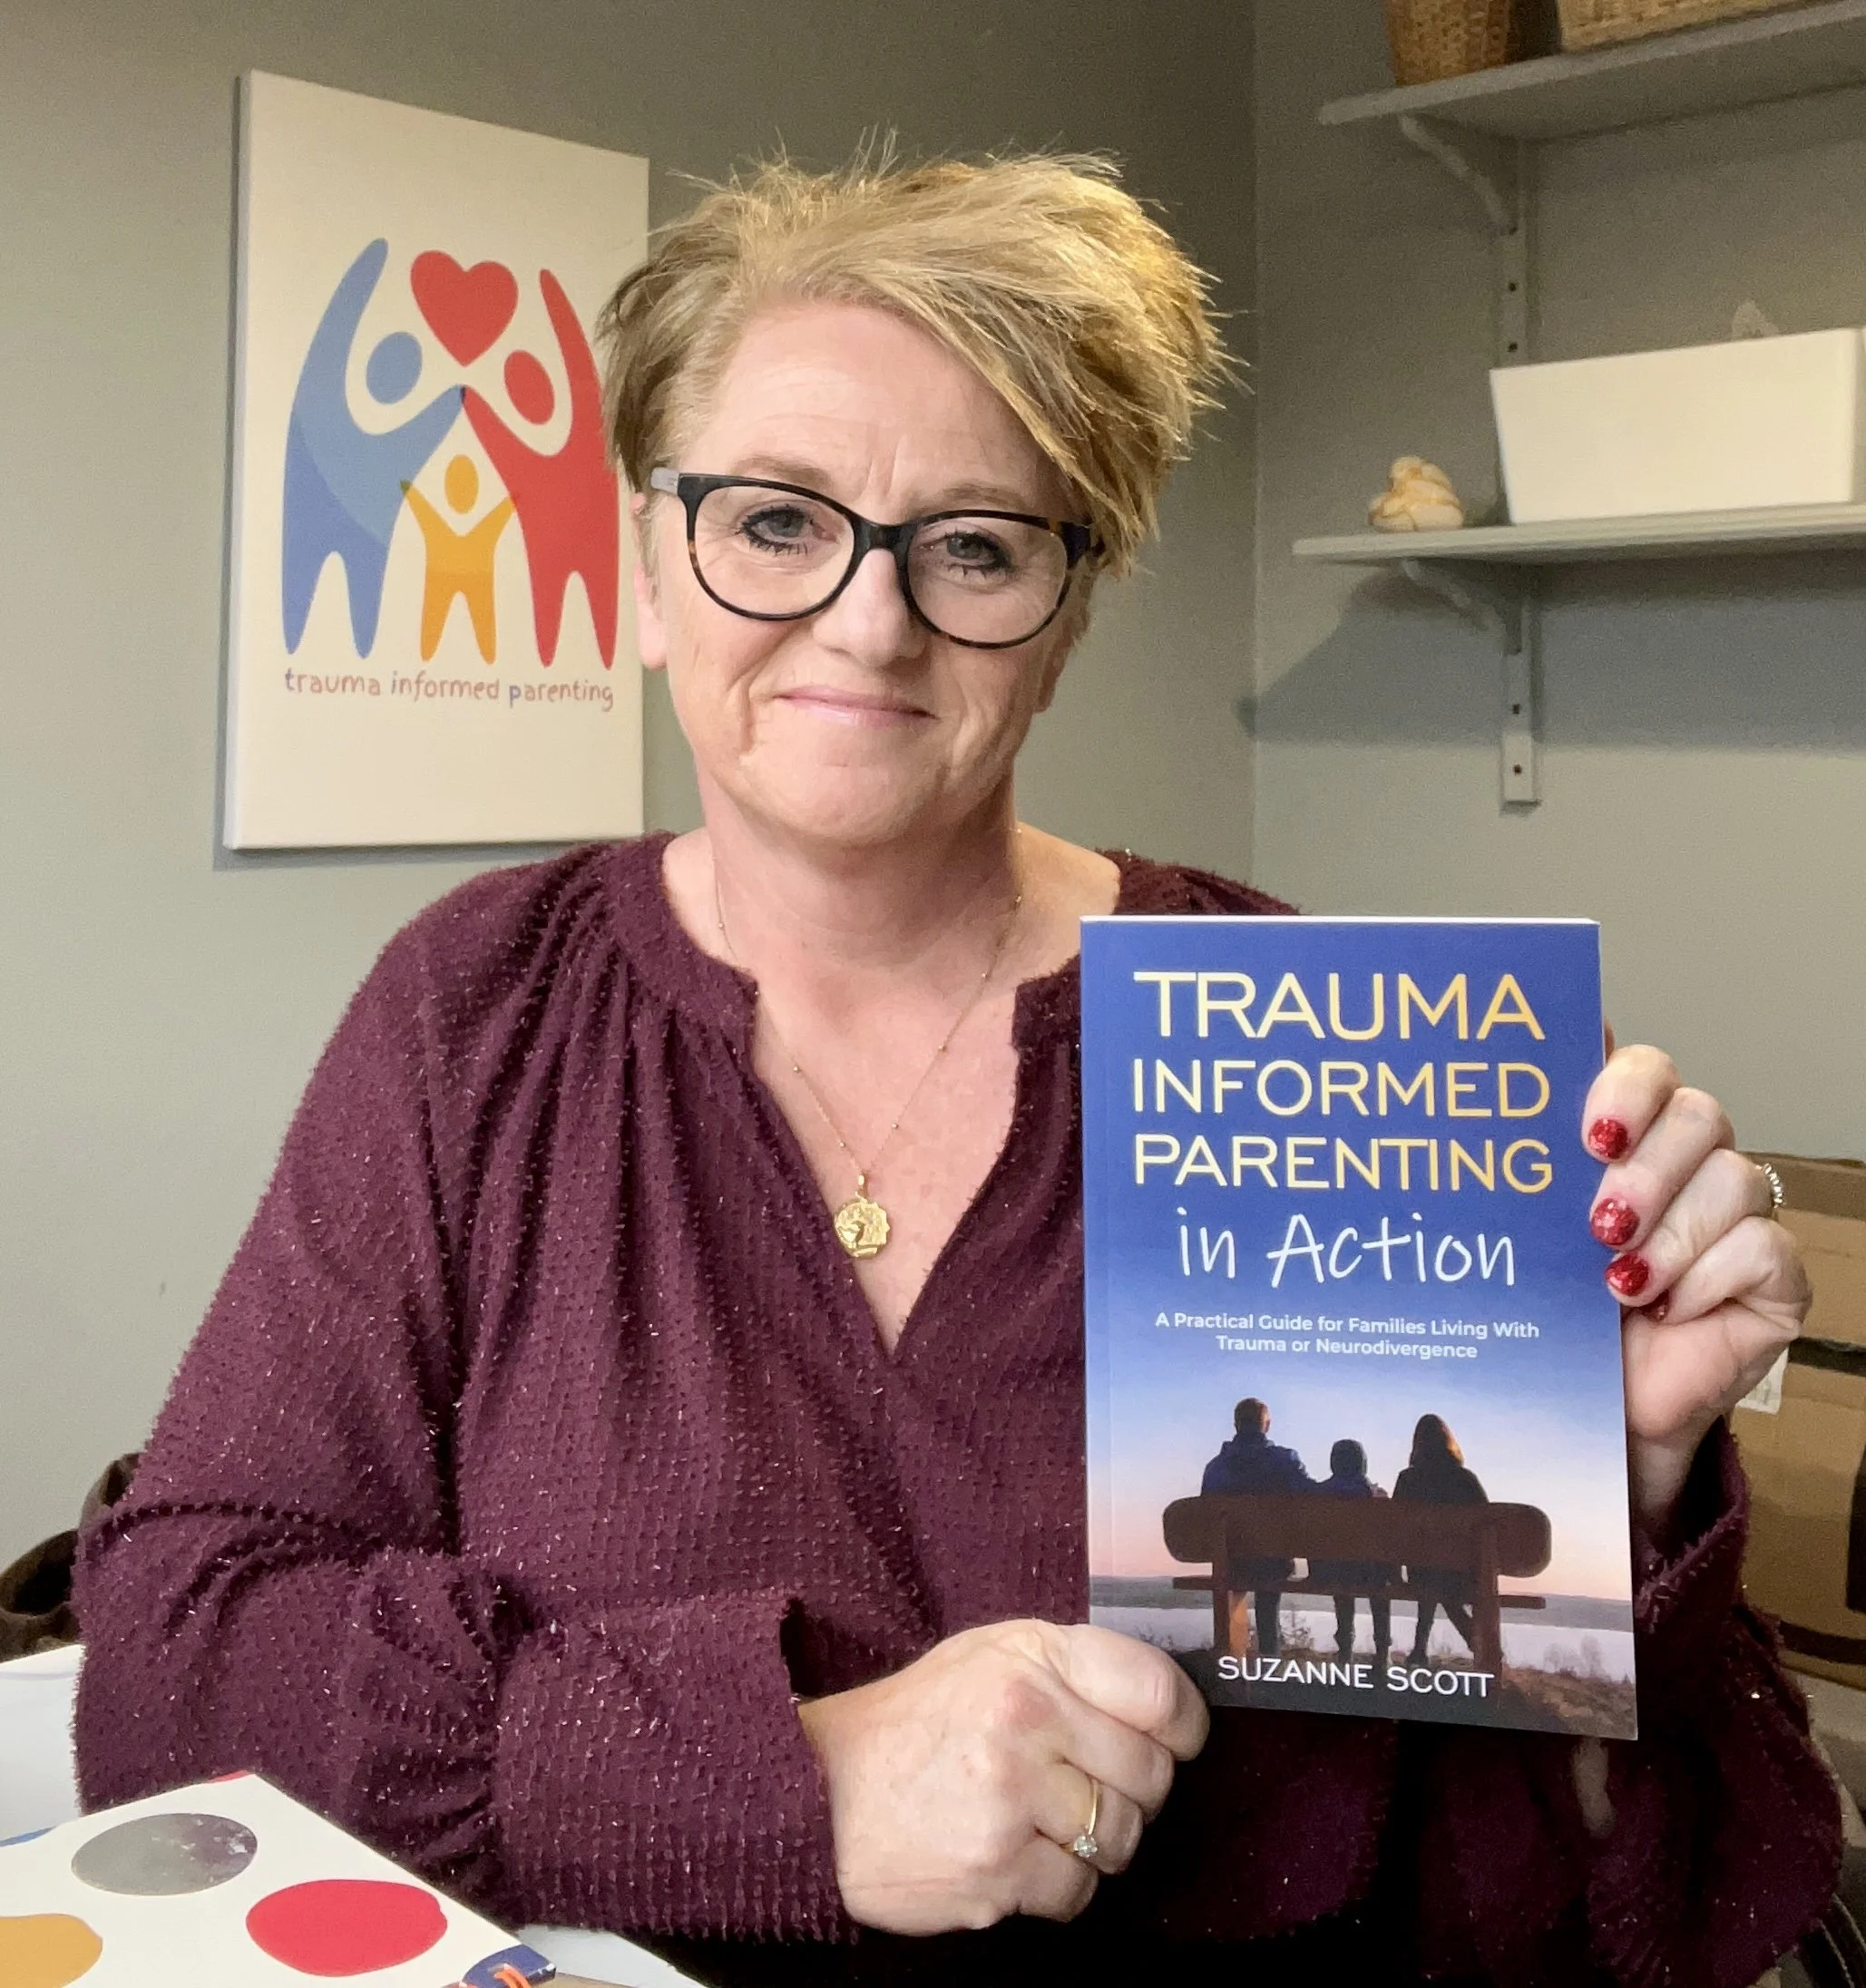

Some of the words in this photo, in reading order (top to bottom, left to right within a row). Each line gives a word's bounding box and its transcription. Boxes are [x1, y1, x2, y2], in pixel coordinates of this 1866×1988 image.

[285, 668, 381, 697] trauma
[391, 669, 499, 701] informed
[508, 679, 613, 712] parenting
[1133, 971, 1546, 1040] TRAUMA
[1133, 1058, 1550, 1117] INFORMED
[1135, 1134, 1553, 1194] PARENTING
[1177, 1207, 1236, 1279] in
[1266, 1212, 1515, 1288] Action
[1155, 1313, 1170, 1328] A
[1175, 1313, 1254, 1330] Practical
[1258, 1316, 1314, 1332] Guide
[1318, 1317, 1343, 1333] for
[1348, 1318, 1425, 1336] Families
[1431, 1320, 1488, 1342] Living
[1493, 1321, 1540, 1339] With
[1216, 1335, 1286, 1351] Trauma
[1292, 1340, 1310, 1352] or
[1315, 1338, 1478, 1360] Neurodivergence
[1217, 1656, 1373, 1690] SUZANNE
[1386, 1666, 1495, 1698] SCOTT
